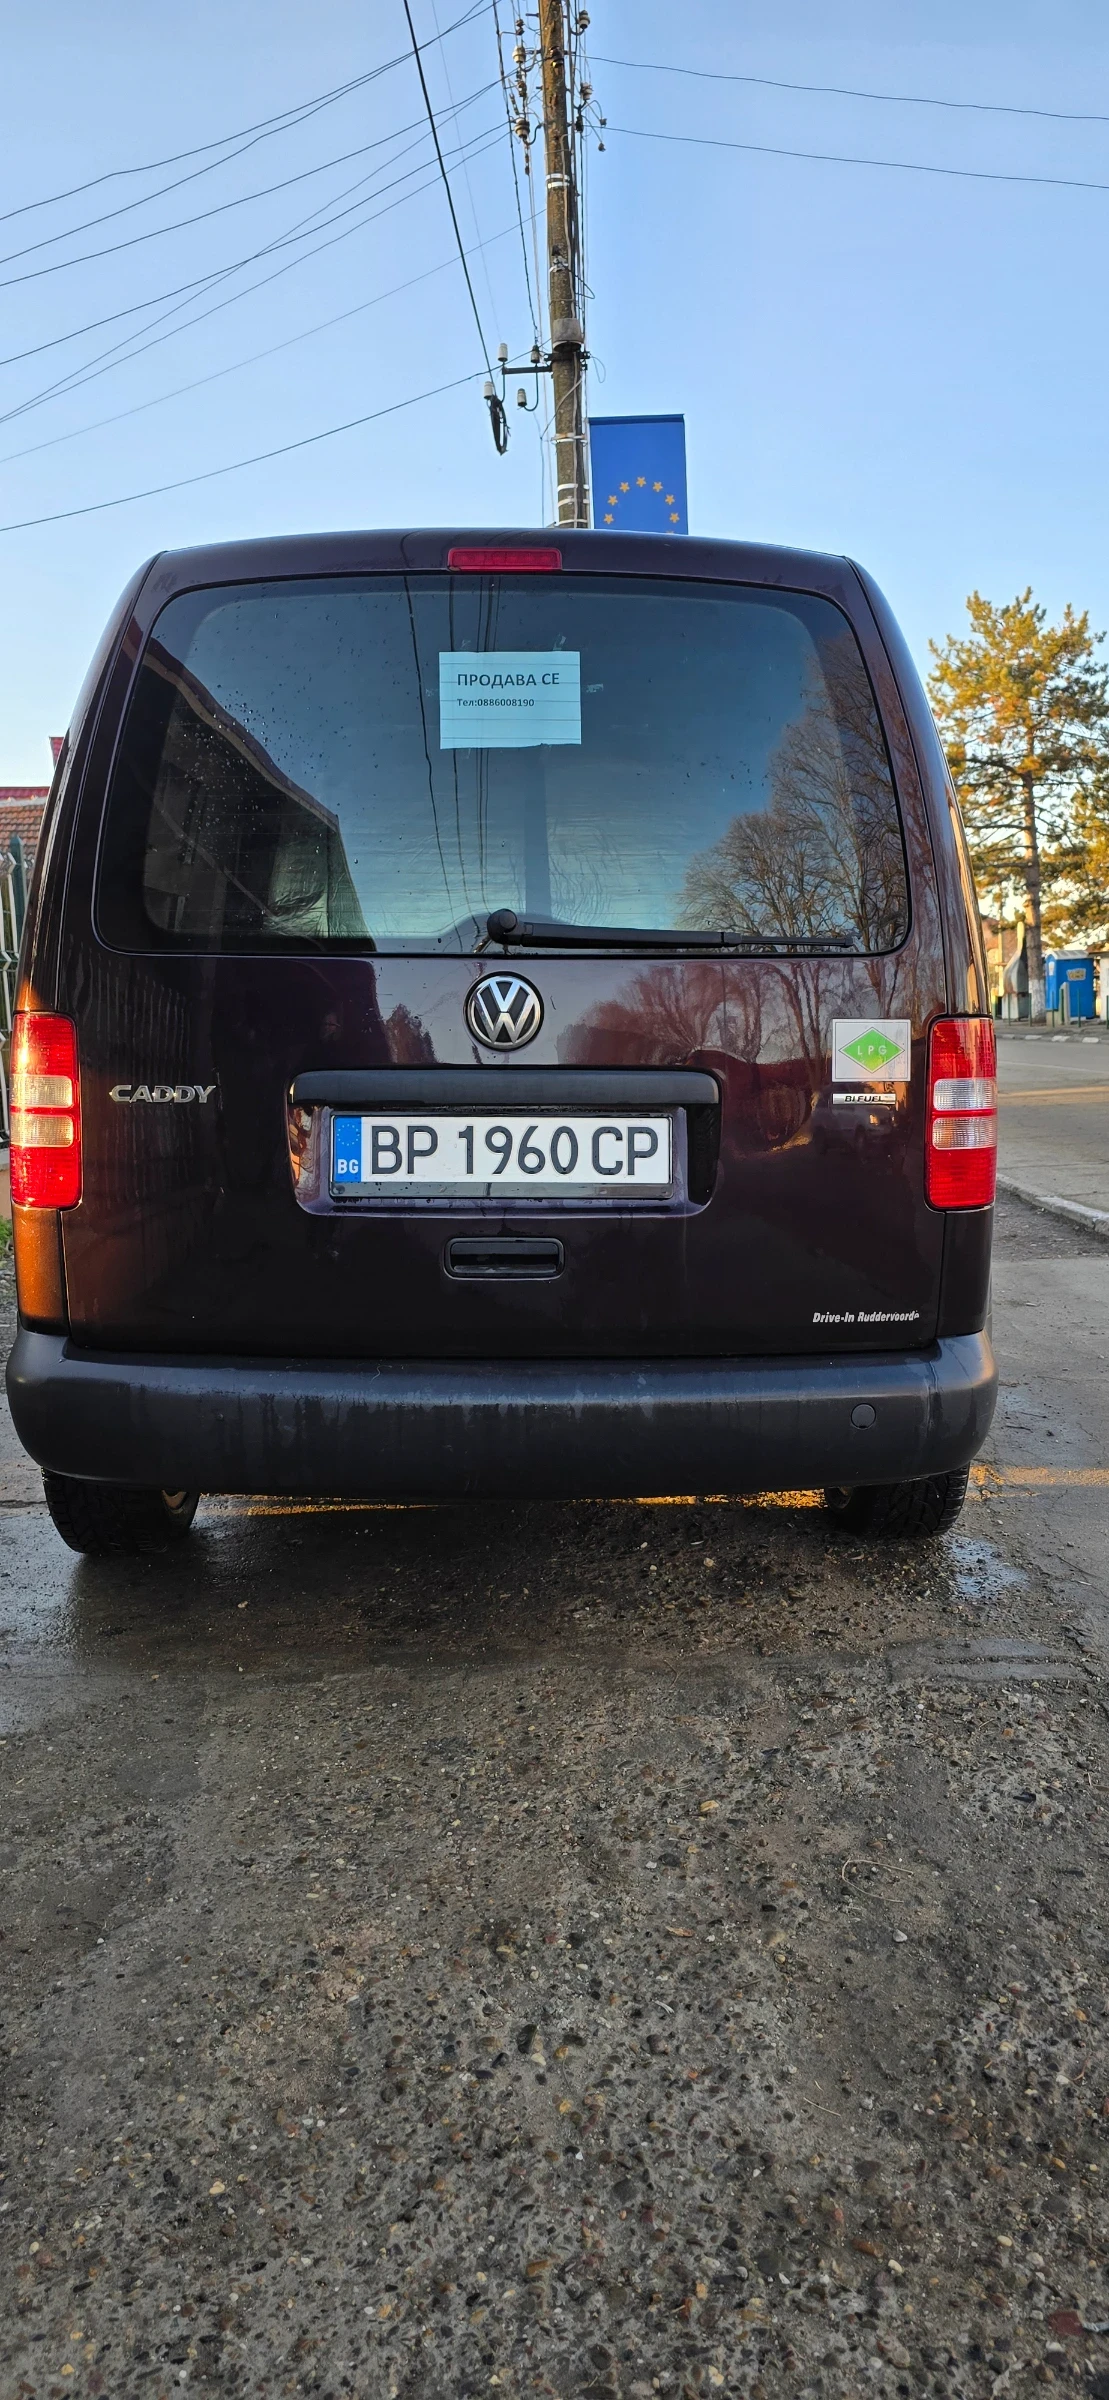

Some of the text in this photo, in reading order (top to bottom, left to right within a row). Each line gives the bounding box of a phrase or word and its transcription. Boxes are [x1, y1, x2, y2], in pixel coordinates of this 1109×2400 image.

[457, 673, 560, 689] ПРОДАВА СЕ
[456, 698, 535, 707] Тел:0886008190
[467, 975, 541, 1050] VW
[857, 1046, 887, 1056] LPG
[109, 1084, 216, 1103] CADDY
[337, 1125, 658, 1176] BG BP 1960 CP
[812, 1311, 855, 1323] Drive-In
